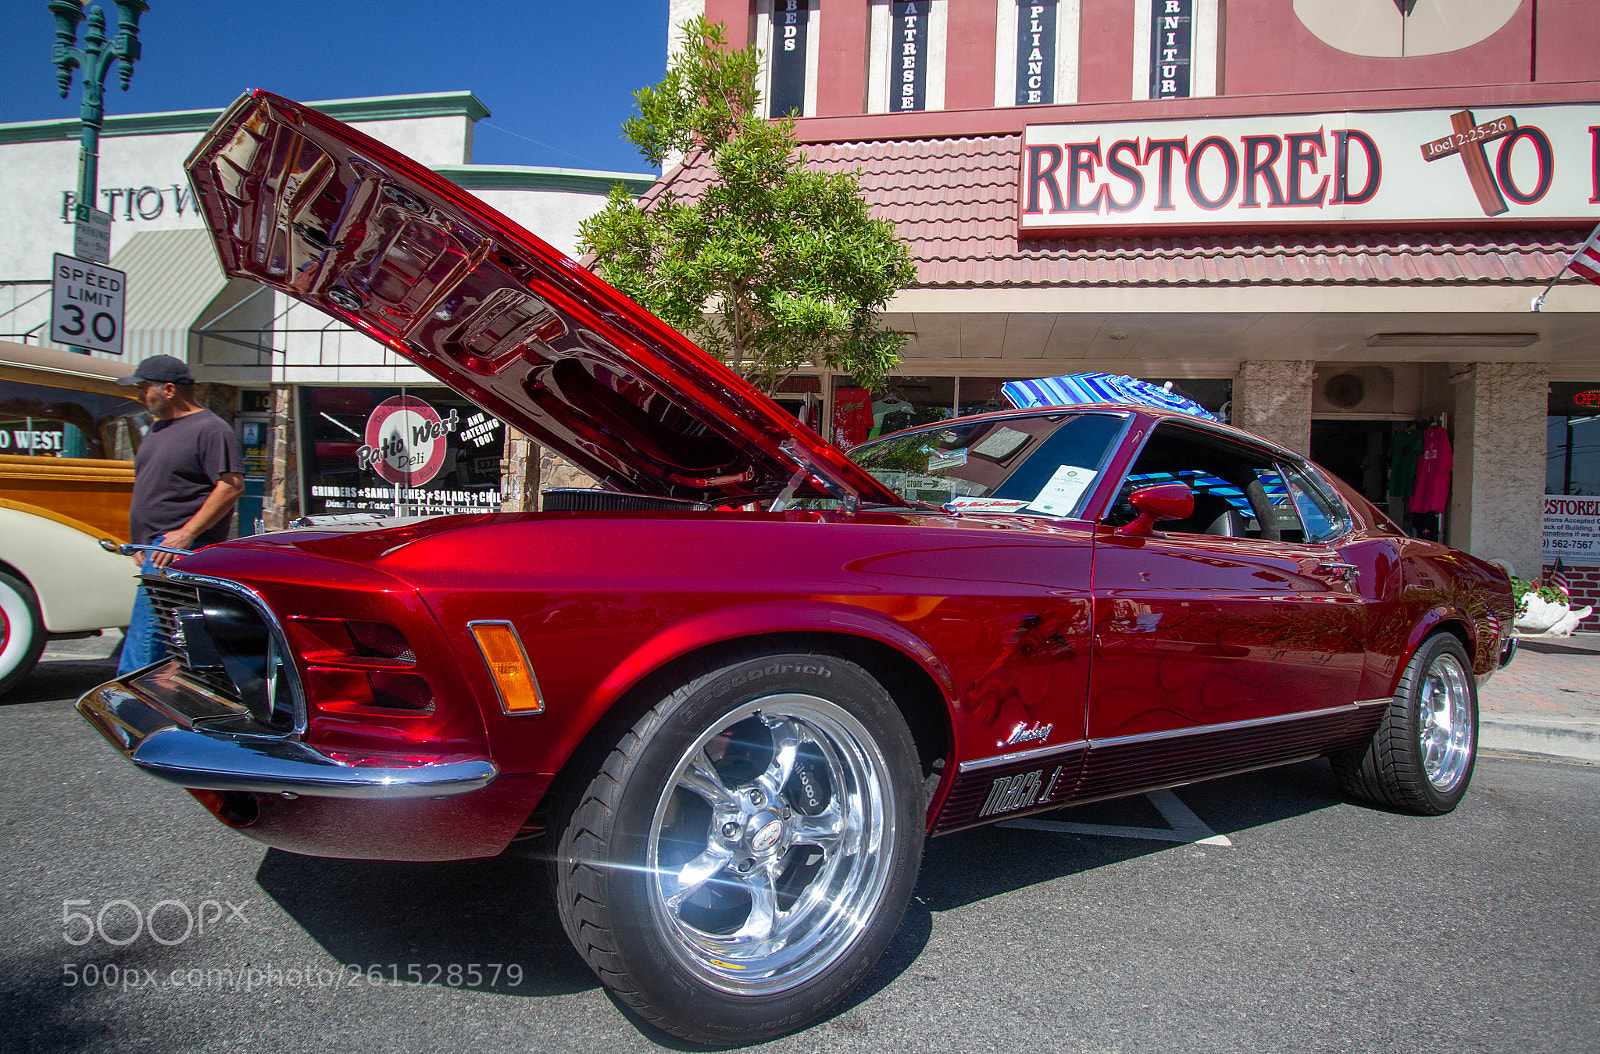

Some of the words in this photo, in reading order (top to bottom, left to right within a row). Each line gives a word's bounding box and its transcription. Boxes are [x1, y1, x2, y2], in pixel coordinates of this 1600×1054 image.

[784, 0, 798, 51] BEDS
[901, 1, 917, 112] ATTRESSE
[1028, 0, 1044, 103] PLIANCE
[1161, 0, 1181, 99] RNITUR
[1429, 137, 1455, 155] Joel
[1456, 119, 1507, 146] 2:25-26
[1023, 125, 1382, 216] RESTORED
[60, 185, 164, 224] PTIO
[79, 207, 86, 219] 2
[77, 224, 109, 242] PARKING
[59, 266, 120, 292] SPEED
[68, 285, 114, 307] LIMIT
[59, 304, 116, 342] 30
[460, 418, 500, 441] CATERING
[467, 413, 484, 427] AND
[13, 430, 63, 449] WEST
[355, 434, 404, 470] Patio
[411, 409, 459, 446] West
[397, 452, 425, 468] Deli
[312, 485, 357, 497] GRINDERS
[434, 490, 471, 502] SALADS
[325, 499, 345, 508] Dine
[346, 500, 356, 508] In
[368, 501, 390, 510] Take
[1552, 539, 1593, 549] 562-7567
[794, 761, 819, 807] ilwood
